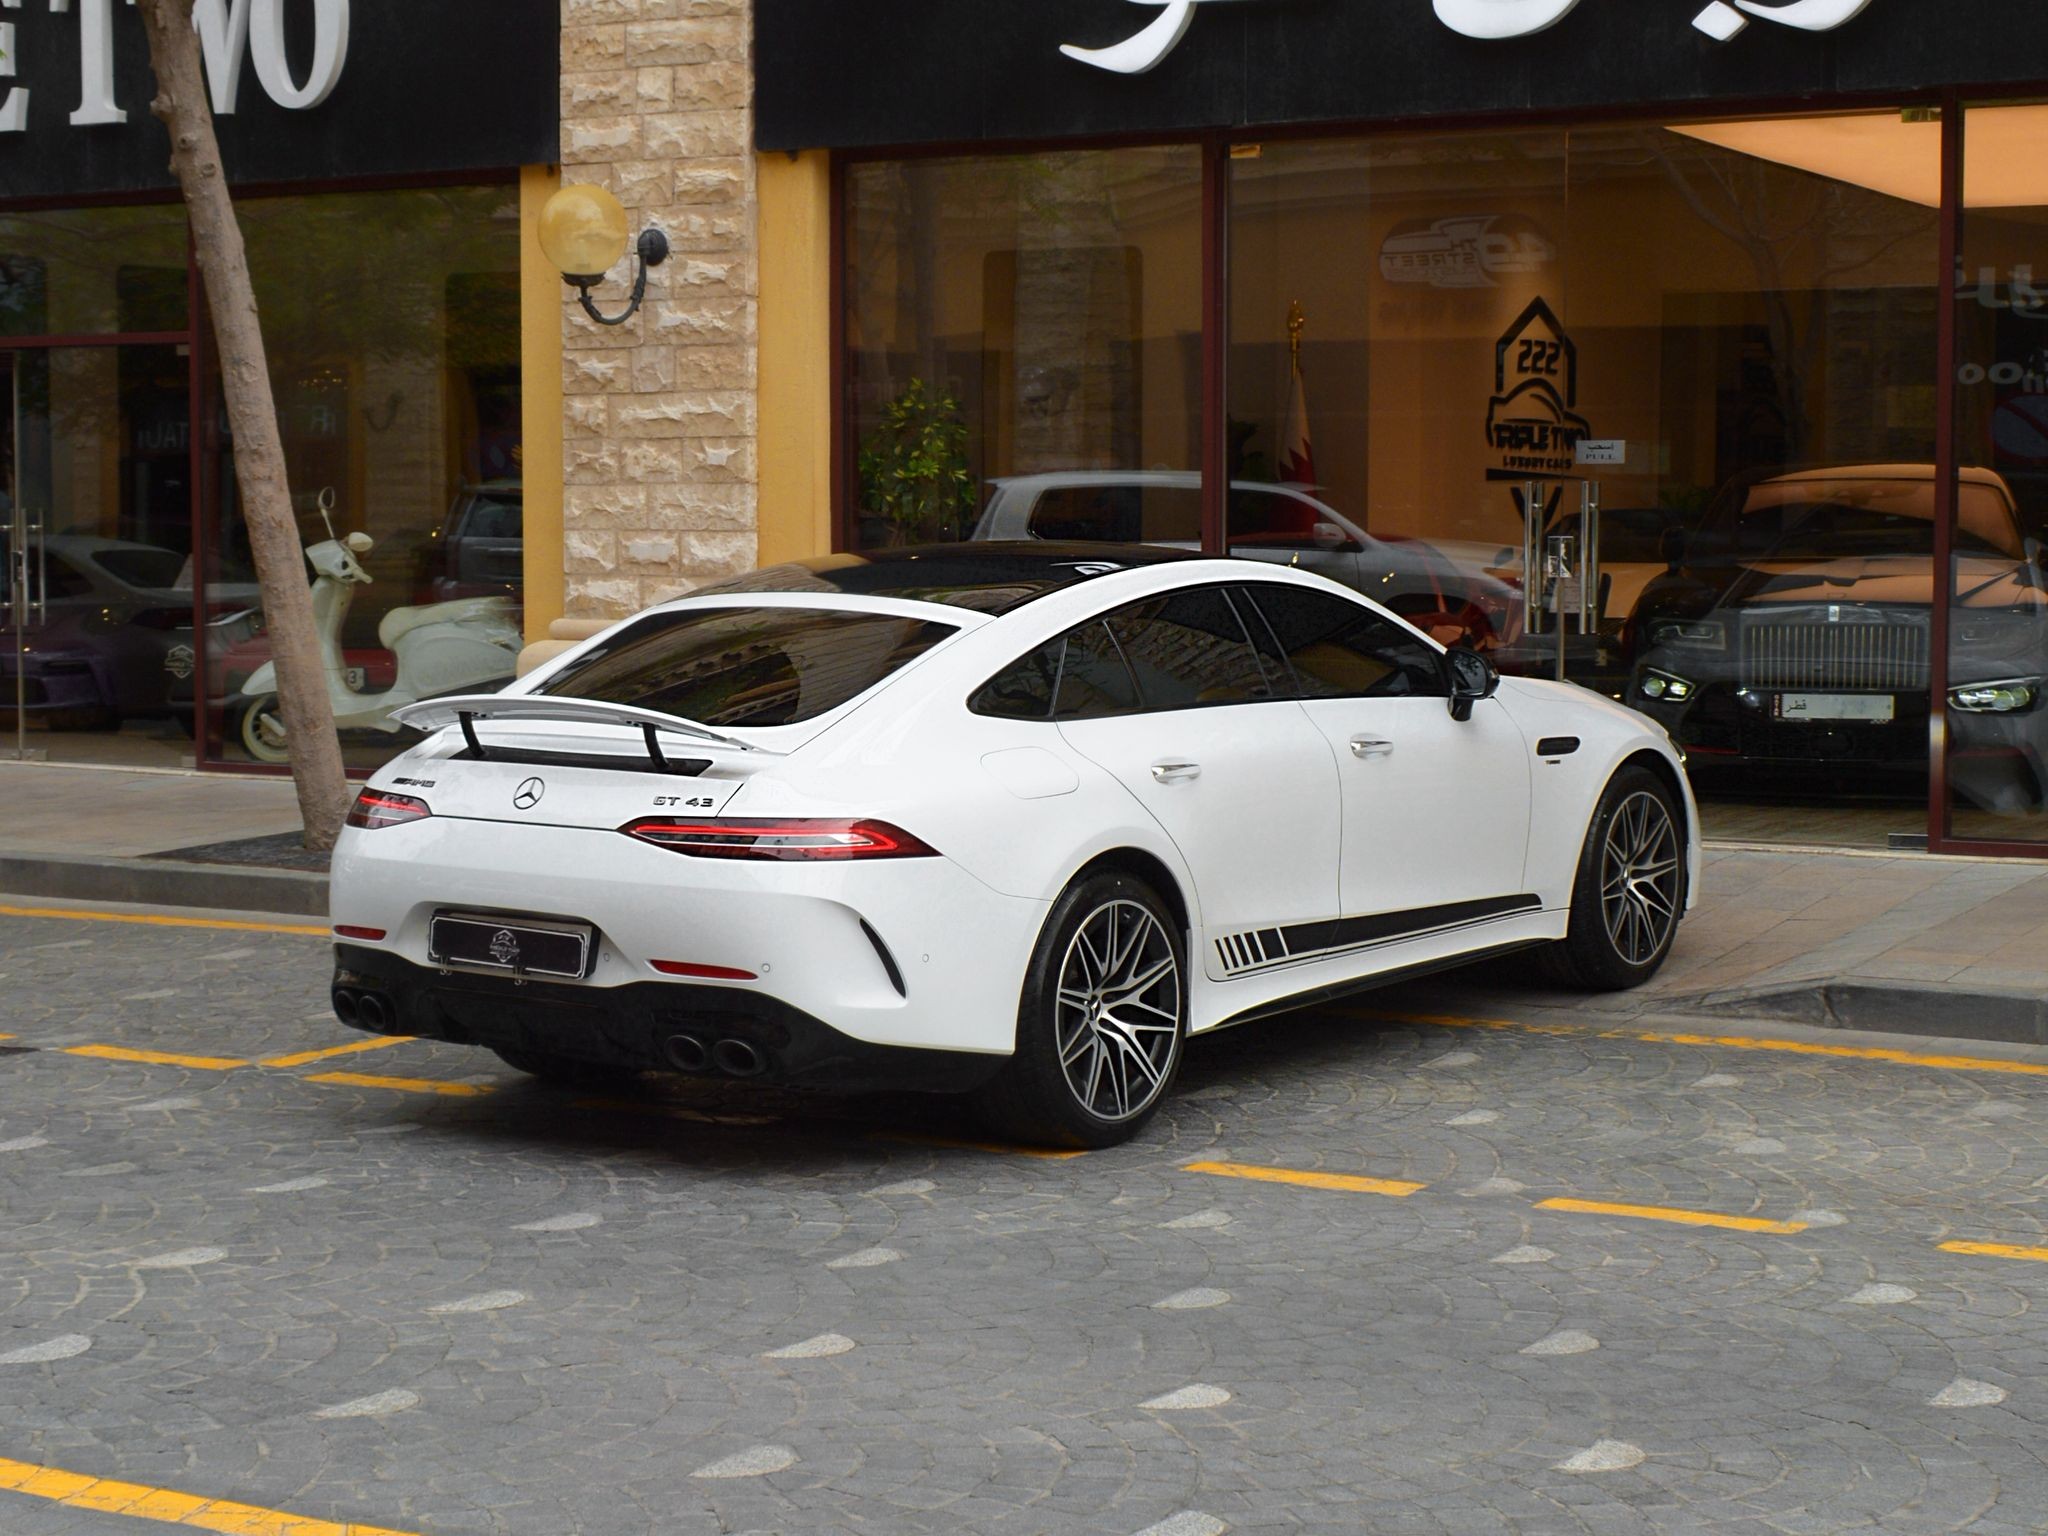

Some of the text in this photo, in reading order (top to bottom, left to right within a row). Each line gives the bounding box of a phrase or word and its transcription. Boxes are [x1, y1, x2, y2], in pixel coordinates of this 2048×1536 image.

[1516, 339, 1561, 375] 222
[653, 796, 713, 807] GT 43
